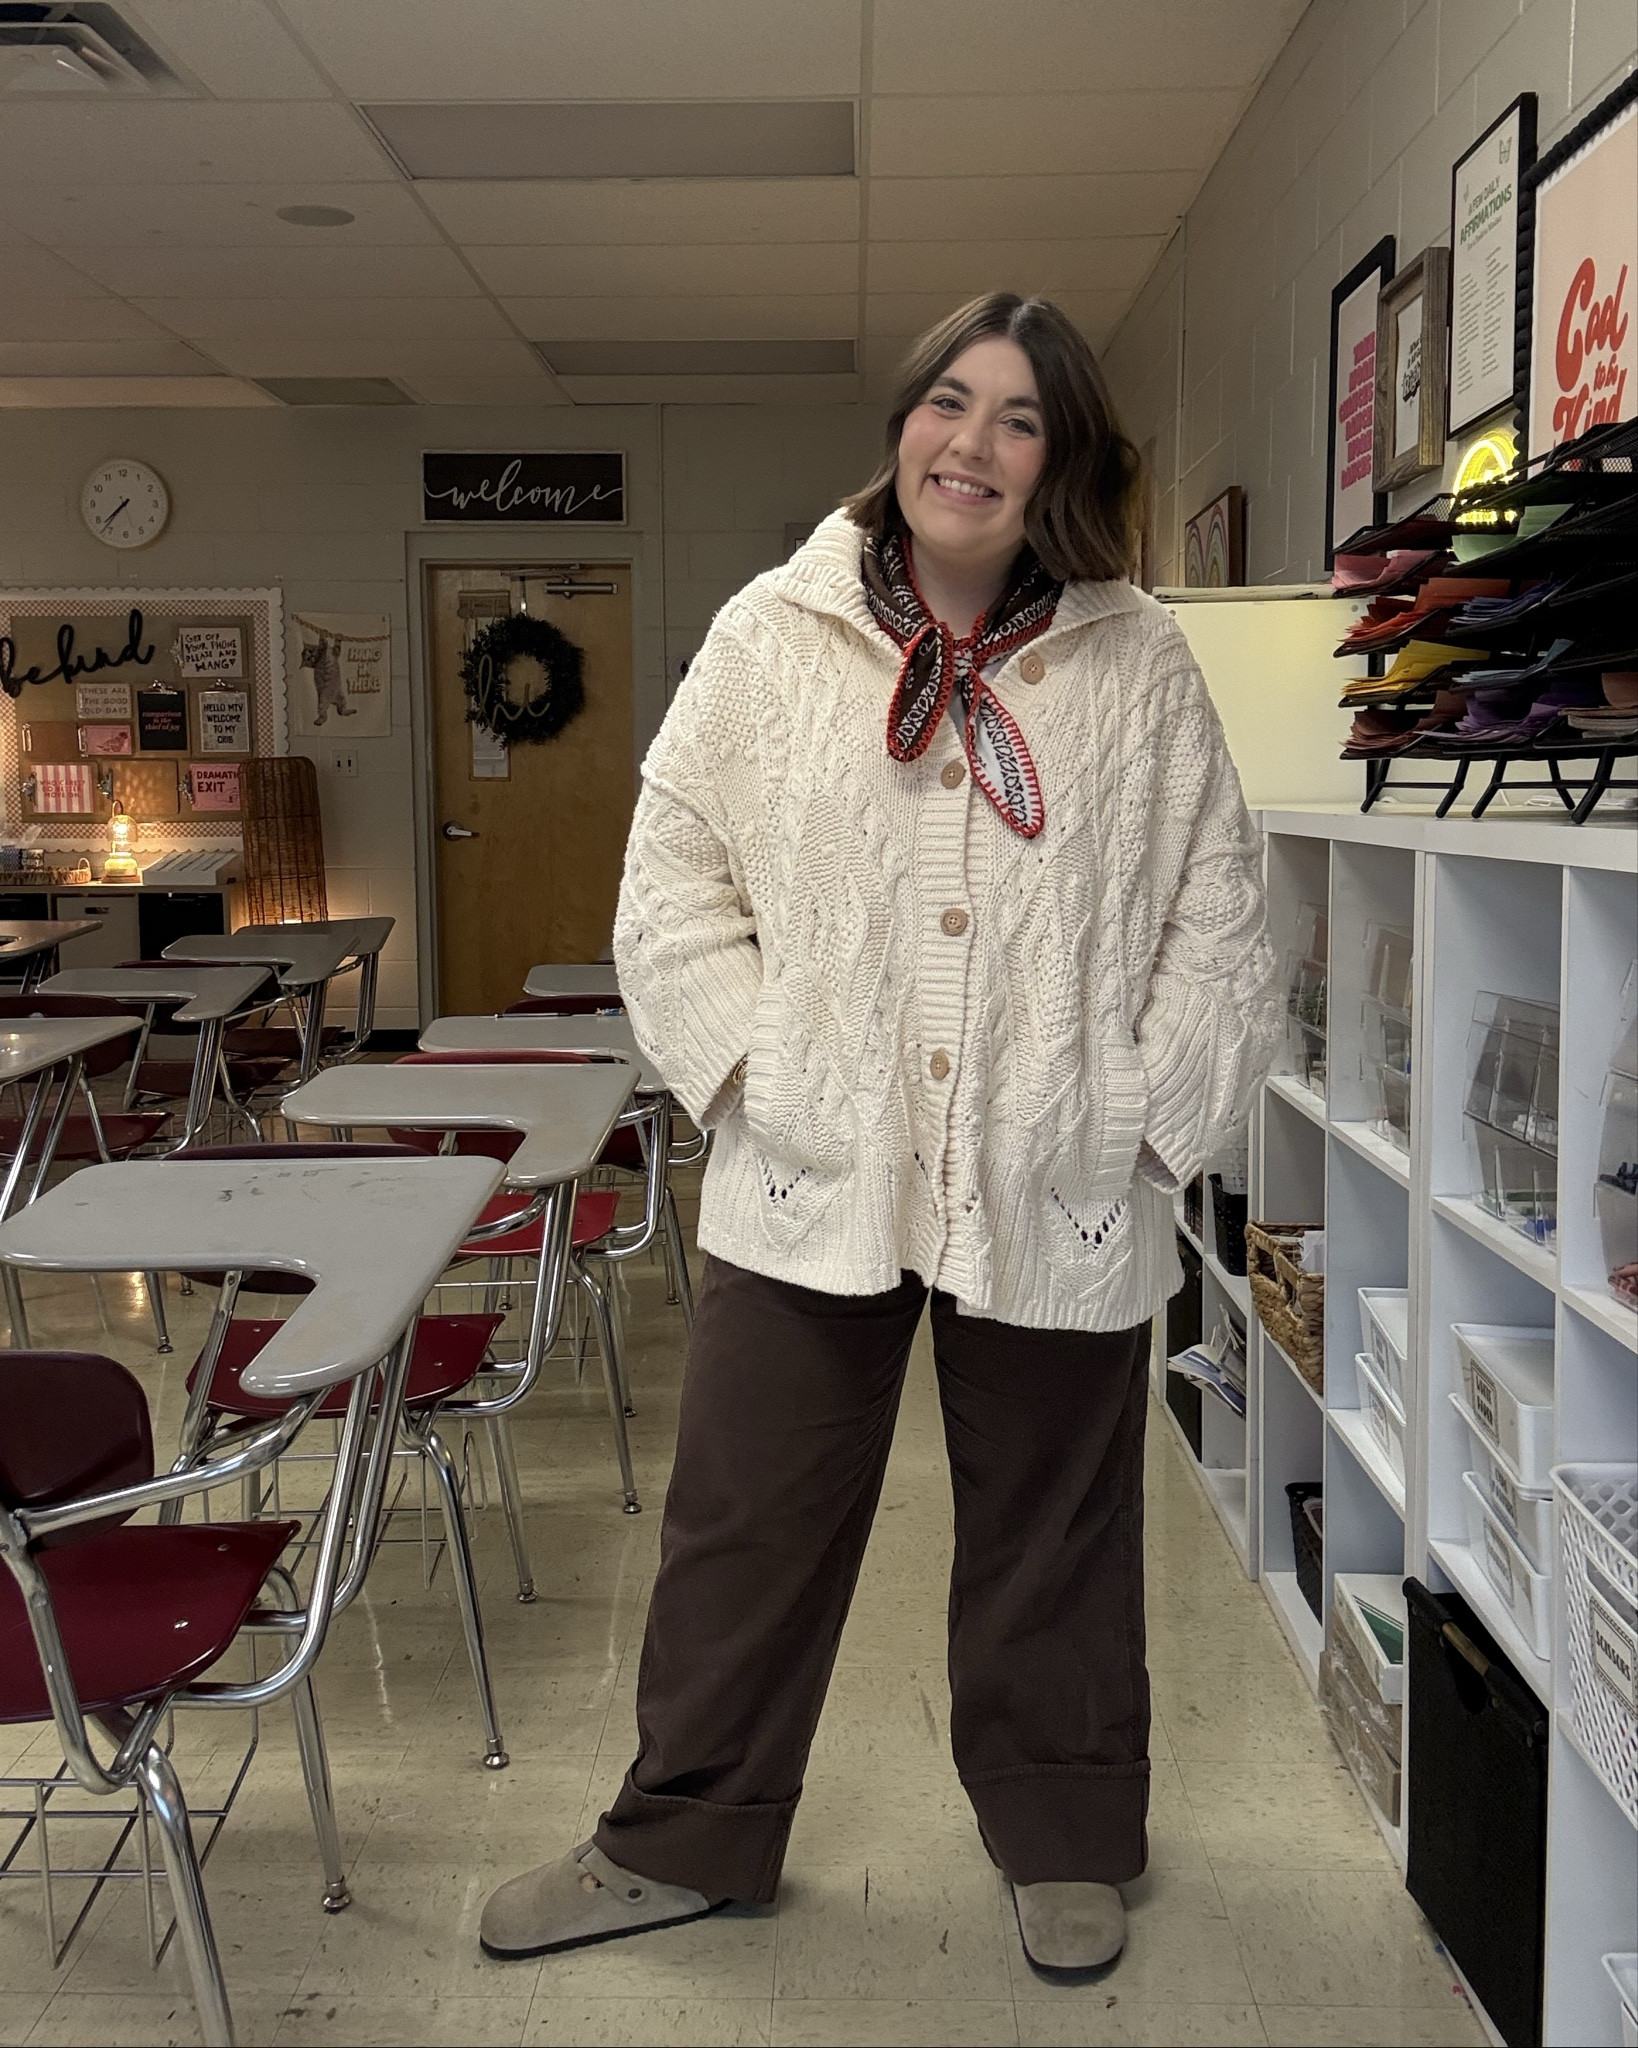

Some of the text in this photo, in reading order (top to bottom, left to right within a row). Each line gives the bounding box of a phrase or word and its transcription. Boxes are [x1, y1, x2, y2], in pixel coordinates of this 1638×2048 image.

[1461, 183, 1512, 245] AFFIRMATIONS
[1555, 258, 1628, 392] Cool
[1593, 361, 1606, 391] to
[1339, 381, 1374, 424] CHANCES
[1553, 368, 1628, 442] Kind
[118, 468, 127, 477] 12
[94, 484, 103, 493] 10
[147, 484, 153, 492] 2
[425, 459, 622, 514] welcome
[90, 500, 96, 508] 9
[152, 500, 158, 508] 3
[95, 515, 101, 524] 8
[108, 526, 113, 534] 7
[138, 526, 144, 534] 5
[123, 531, 129, 539] 6
[211, 640, 237, 650] PHONE
[0, 609, 155, 698] be kind
[186, 650, 237, 663] PLEASE AND
[203, 703, 243, 712] HELLO MTV
[207, 714, 240, 723] WELCOME
[213, 725, 237, 734] TO MY
[217, 735, 233, 744] CRIB
[198, 782, 225, 792] EXIT
[1596, 1629, 1631, 1681] SCISSORS
